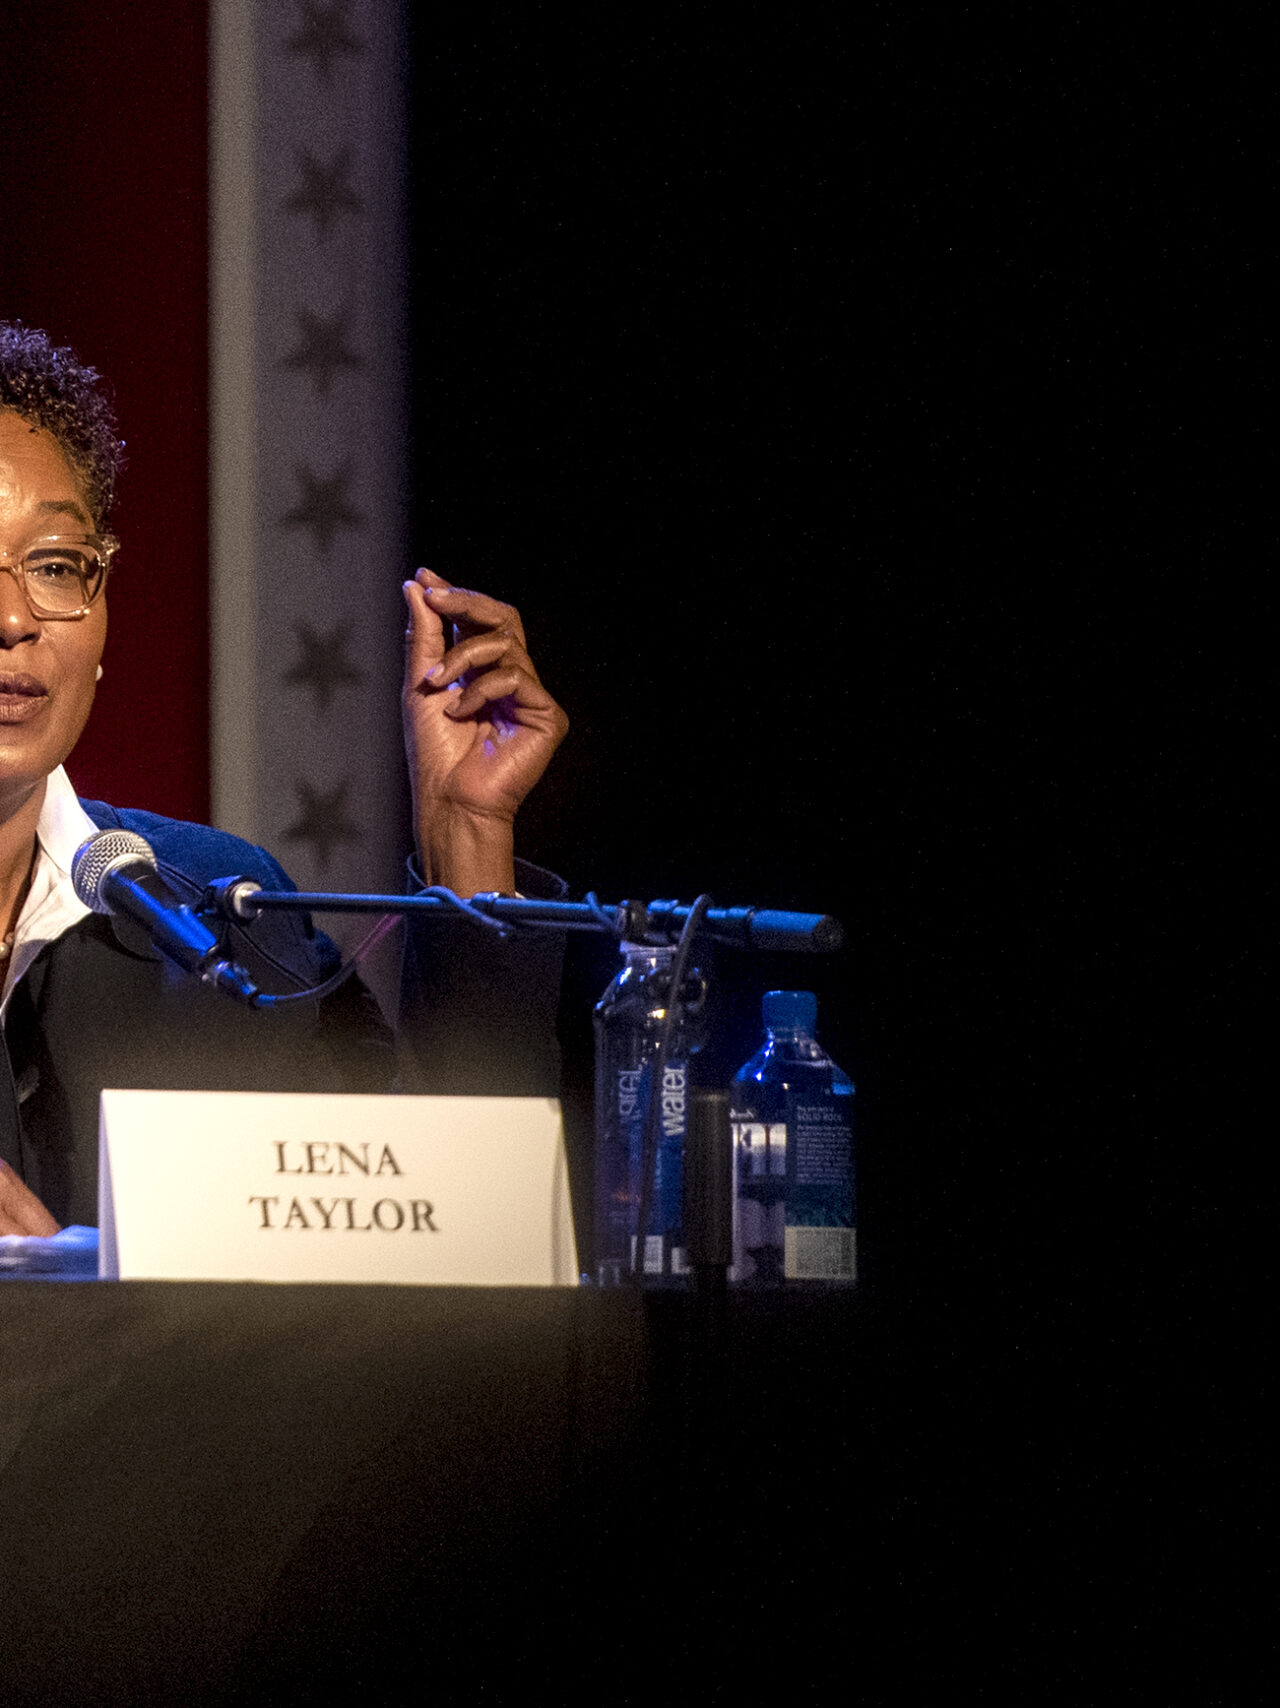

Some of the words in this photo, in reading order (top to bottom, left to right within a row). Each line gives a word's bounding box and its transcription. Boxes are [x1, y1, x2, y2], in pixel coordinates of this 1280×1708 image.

[662, 1065, 685, 1136] water
[275, 1141, 402, 1176] LENA
[249, 1198, 440, 1233] TAYLOR
